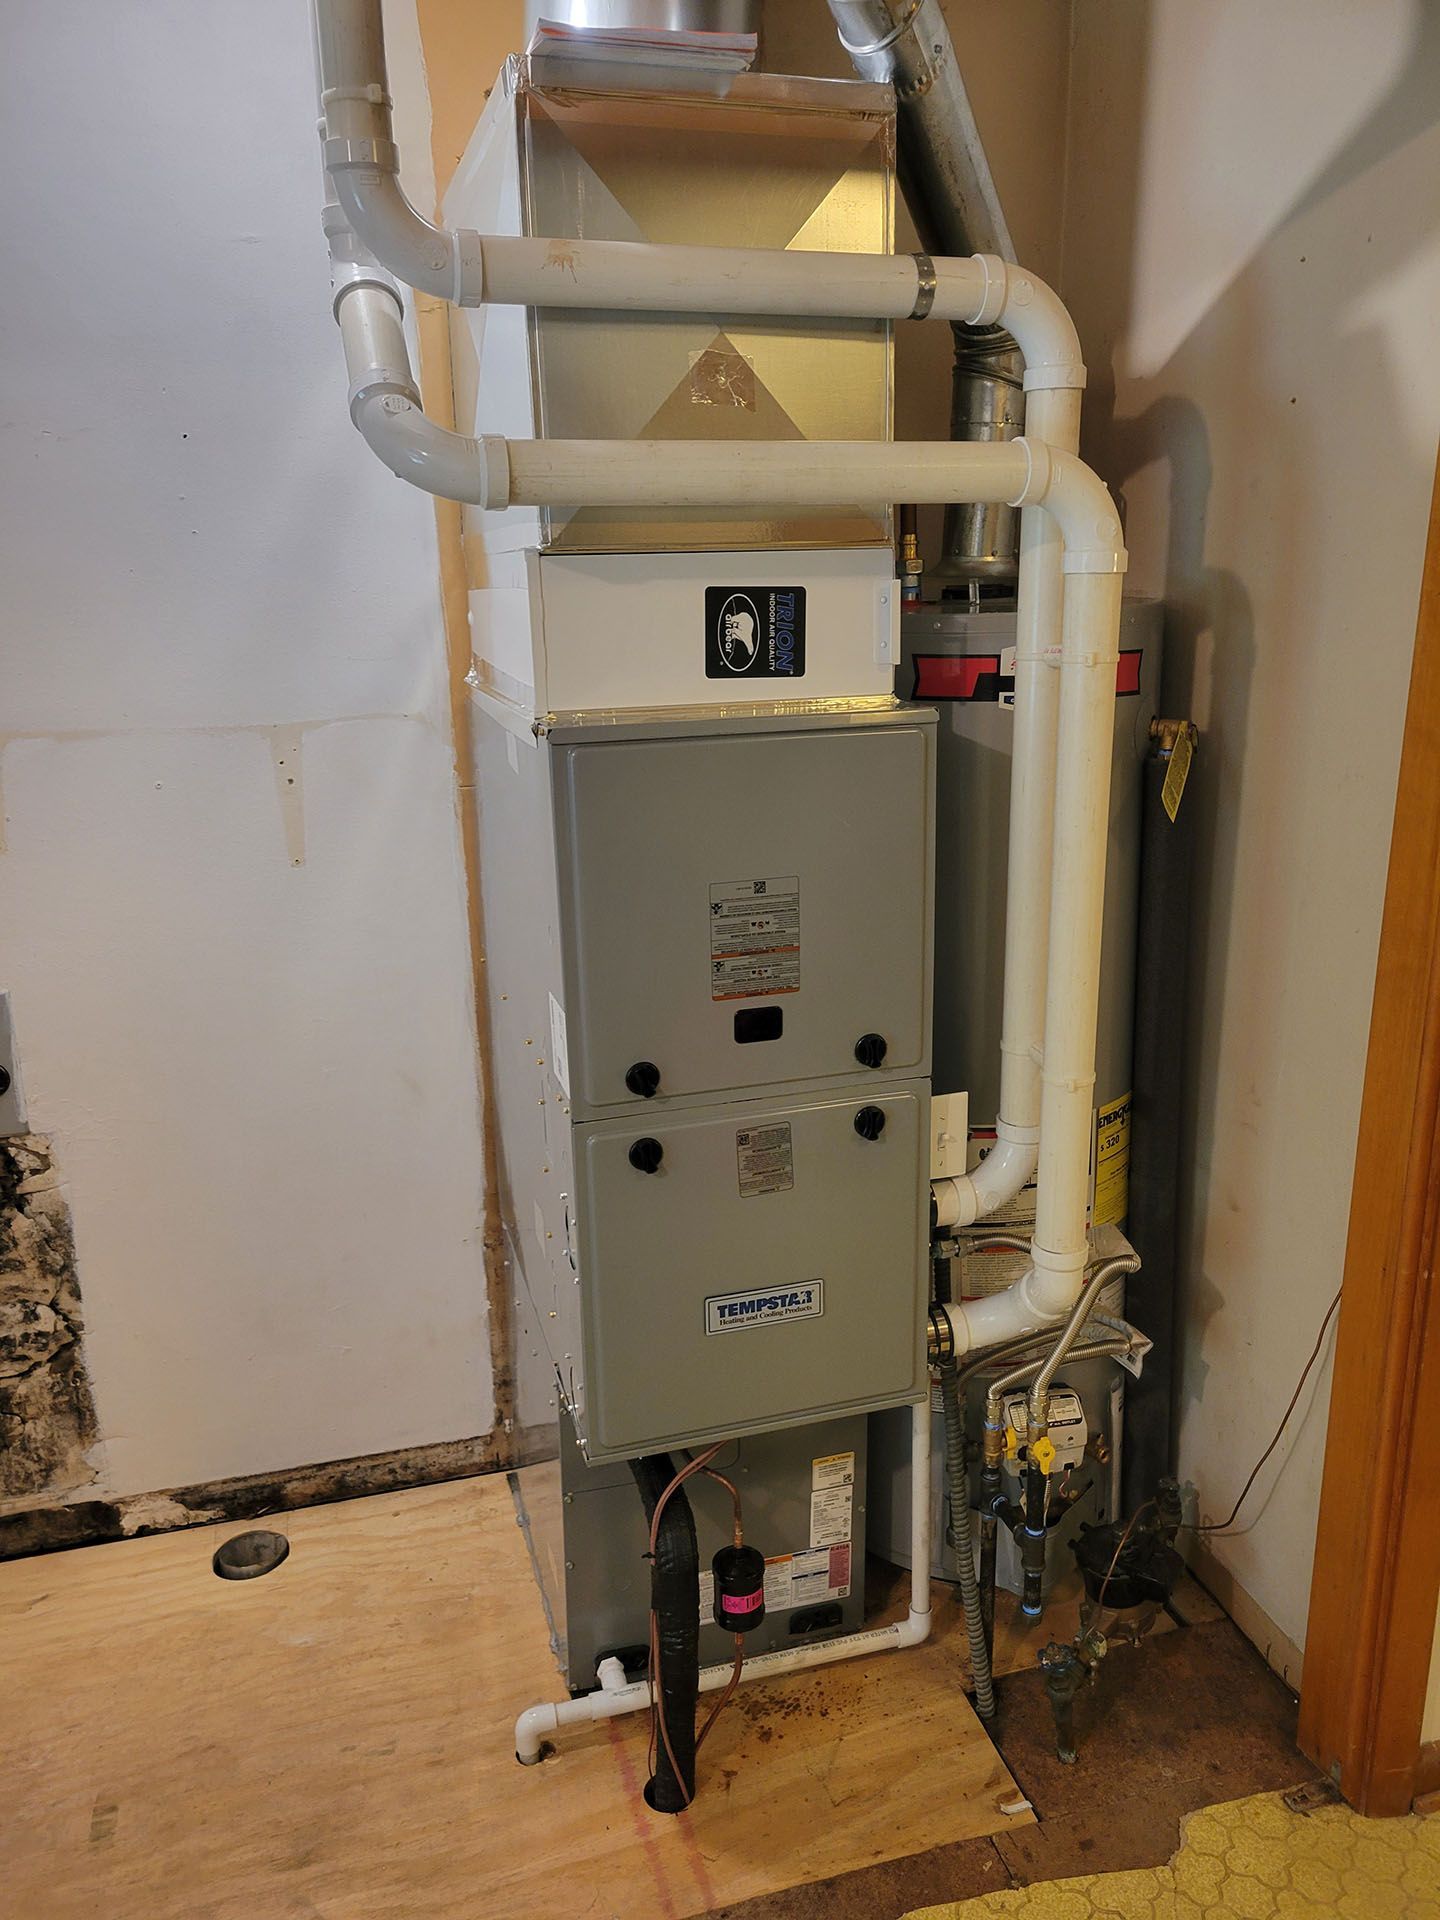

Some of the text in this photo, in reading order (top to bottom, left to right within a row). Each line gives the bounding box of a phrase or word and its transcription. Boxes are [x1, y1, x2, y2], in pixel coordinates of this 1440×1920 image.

[777, 593, 795, 671] TRION
[717, 1290, 812, 1318] TEMPSTAR
[719, 1305, 812, 1326] Heating and Cooling Products
